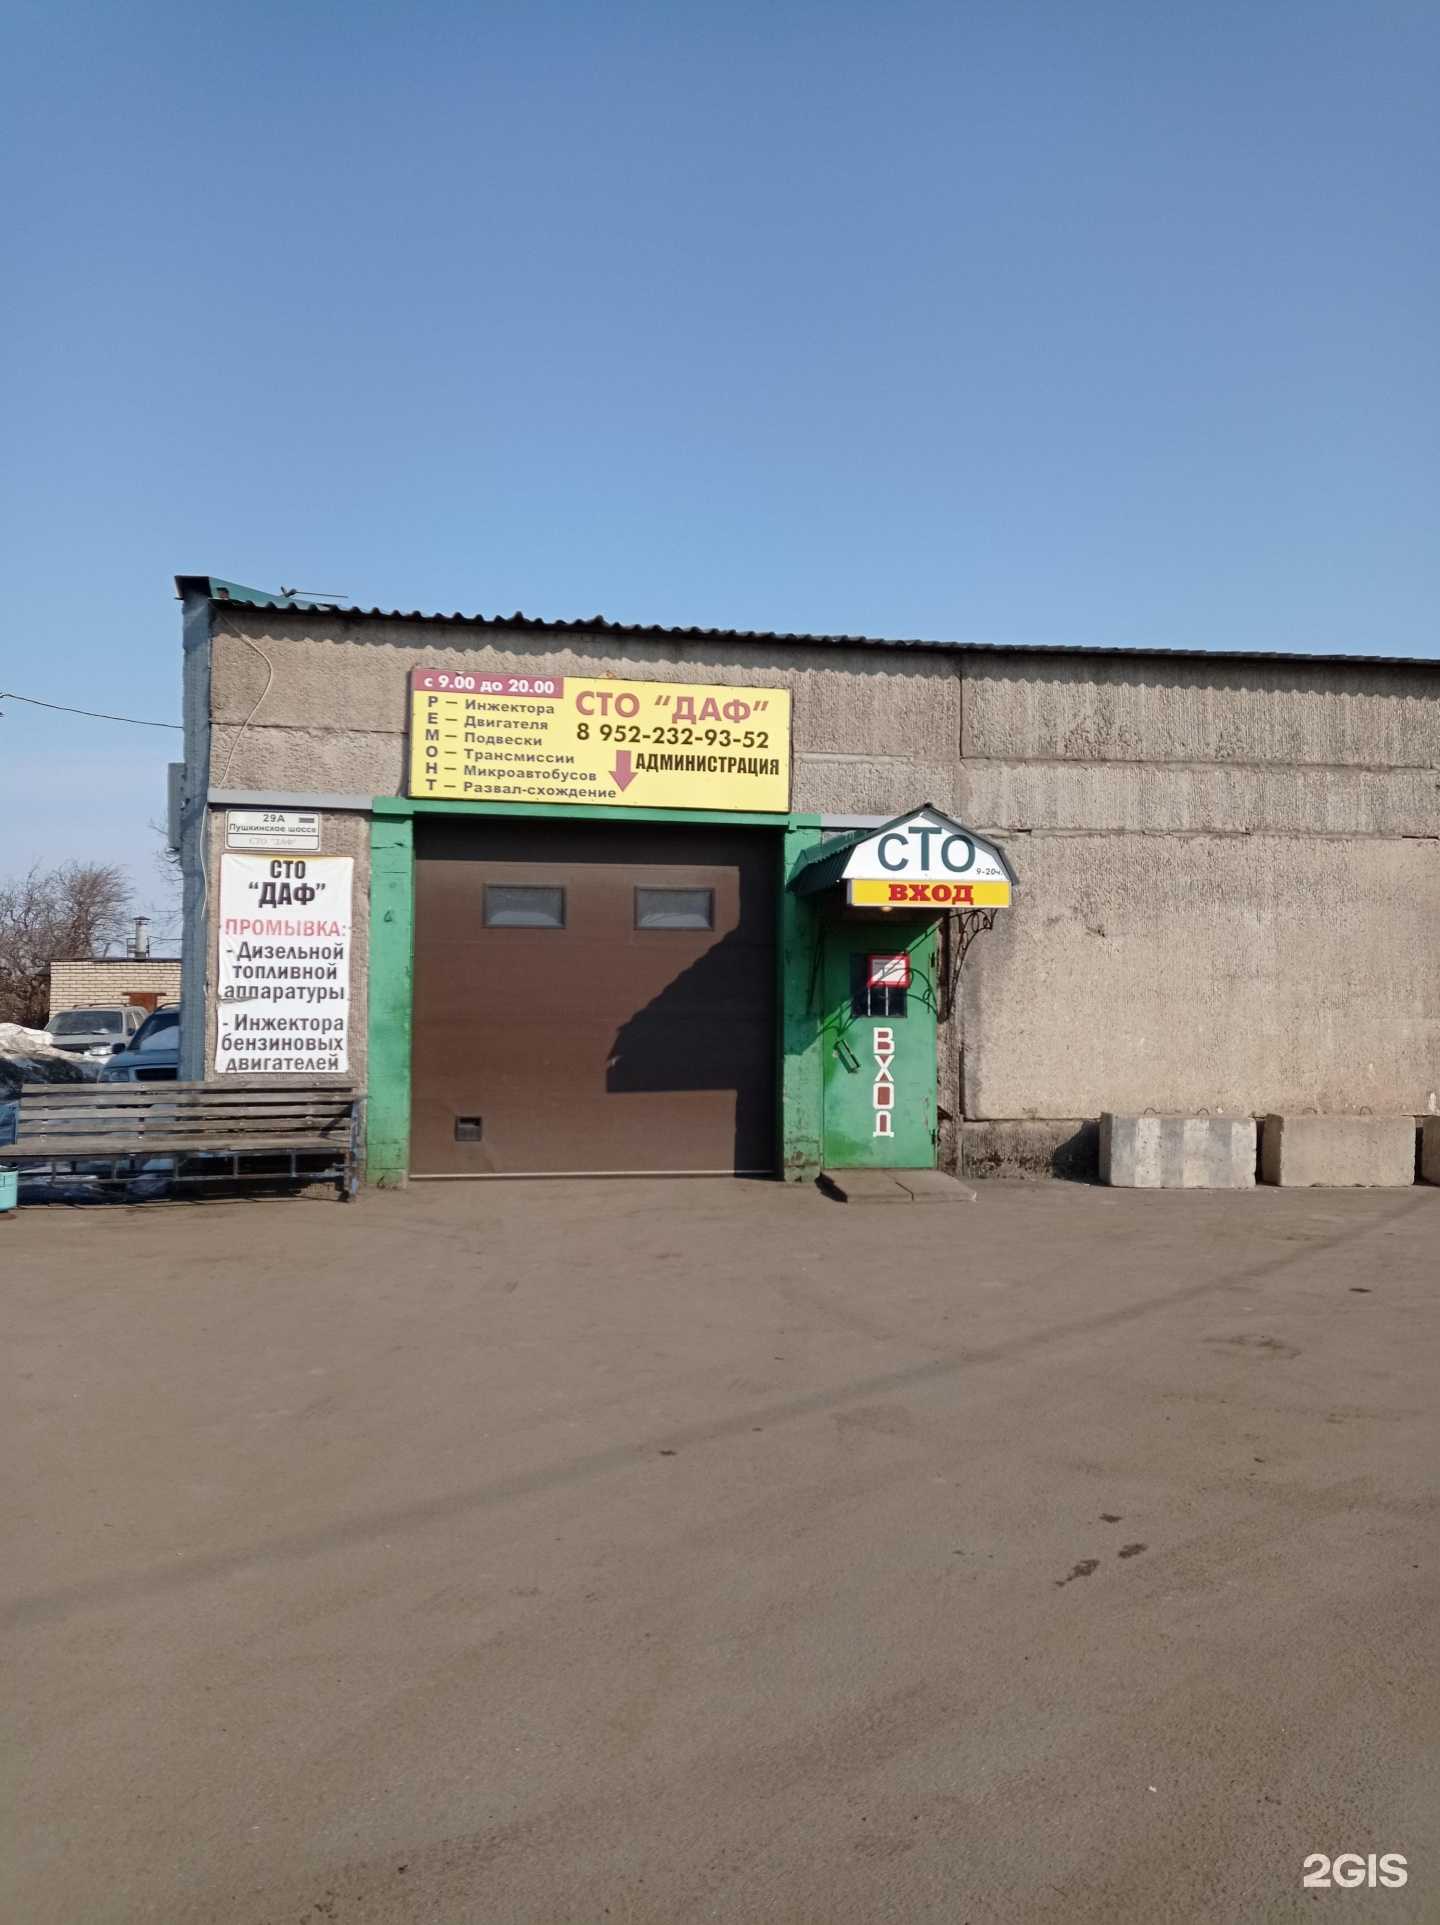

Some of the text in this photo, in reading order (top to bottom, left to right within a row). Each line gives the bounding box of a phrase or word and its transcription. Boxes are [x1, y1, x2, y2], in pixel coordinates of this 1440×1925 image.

[424, 675, 554, 693] с 9.00 до 20.00
[465, 698, 555, 715] Инжектора
[576, 691, 640, 718] СТО
[464, 715, 549, 730] Двигателя
[464, 732, 542, 748] Подвески
[576, 723, 769, 749] 8 952-232-93-52
[464, 748, 575, 764] Трансмиссии
[635, 753, 780, 776] АДМИНИСТРАЦИЯ
[464, 765, 597, 783] Микроавтобусов
[463, 782, 617, 799] Развал-схождение
[263, 814, 285, 822] 29А
[229, 823, 286, 832] Пушкинское
[877, 826, 977, 874] СТО
[270, 859, 306, 879] СТО
[888, 884, 975, 906] ВХОД
[224, 918, 347, 937] ПРОМЫВКА:
[237, 941, 344, 961] Дизельной
[232, 963, 338, 980] топливной
[224, 985, 345, 1003] аппаратуры
[234, 1013, 344, 1035] Инжектора
[221, 1033, 344, 1051] бензиновых
[225, 1053, 339, 1072] двигателей
[872, 1027, 895, 1138] ВХОД
